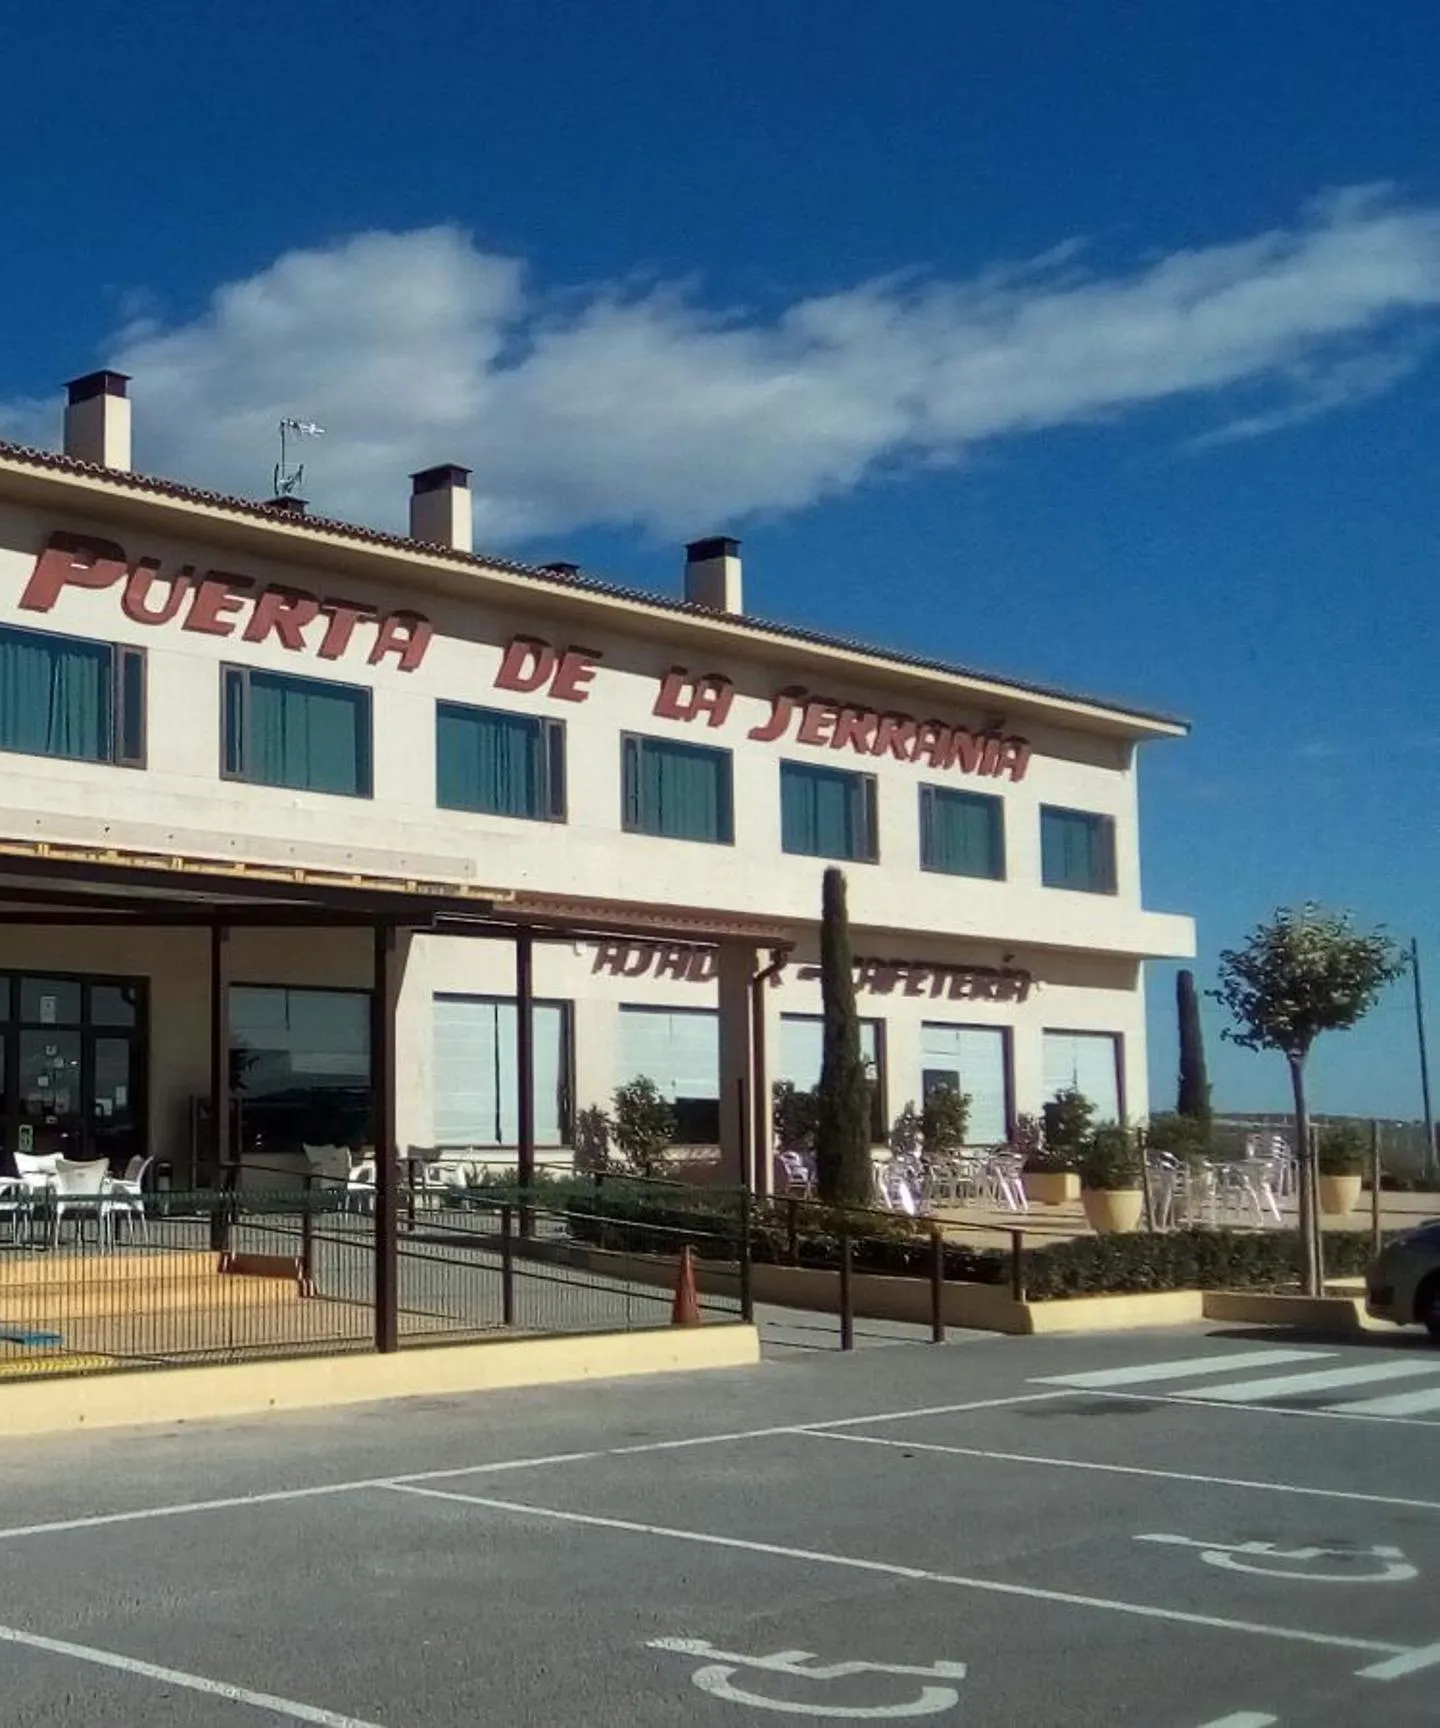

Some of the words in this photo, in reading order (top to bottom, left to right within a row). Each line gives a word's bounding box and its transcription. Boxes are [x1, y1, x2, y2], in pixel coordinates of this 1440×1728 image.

[18, 530, 434, 673] PUERTA
[493, 634, 603, 702] DE
[653, 666, 734, 728] LA
